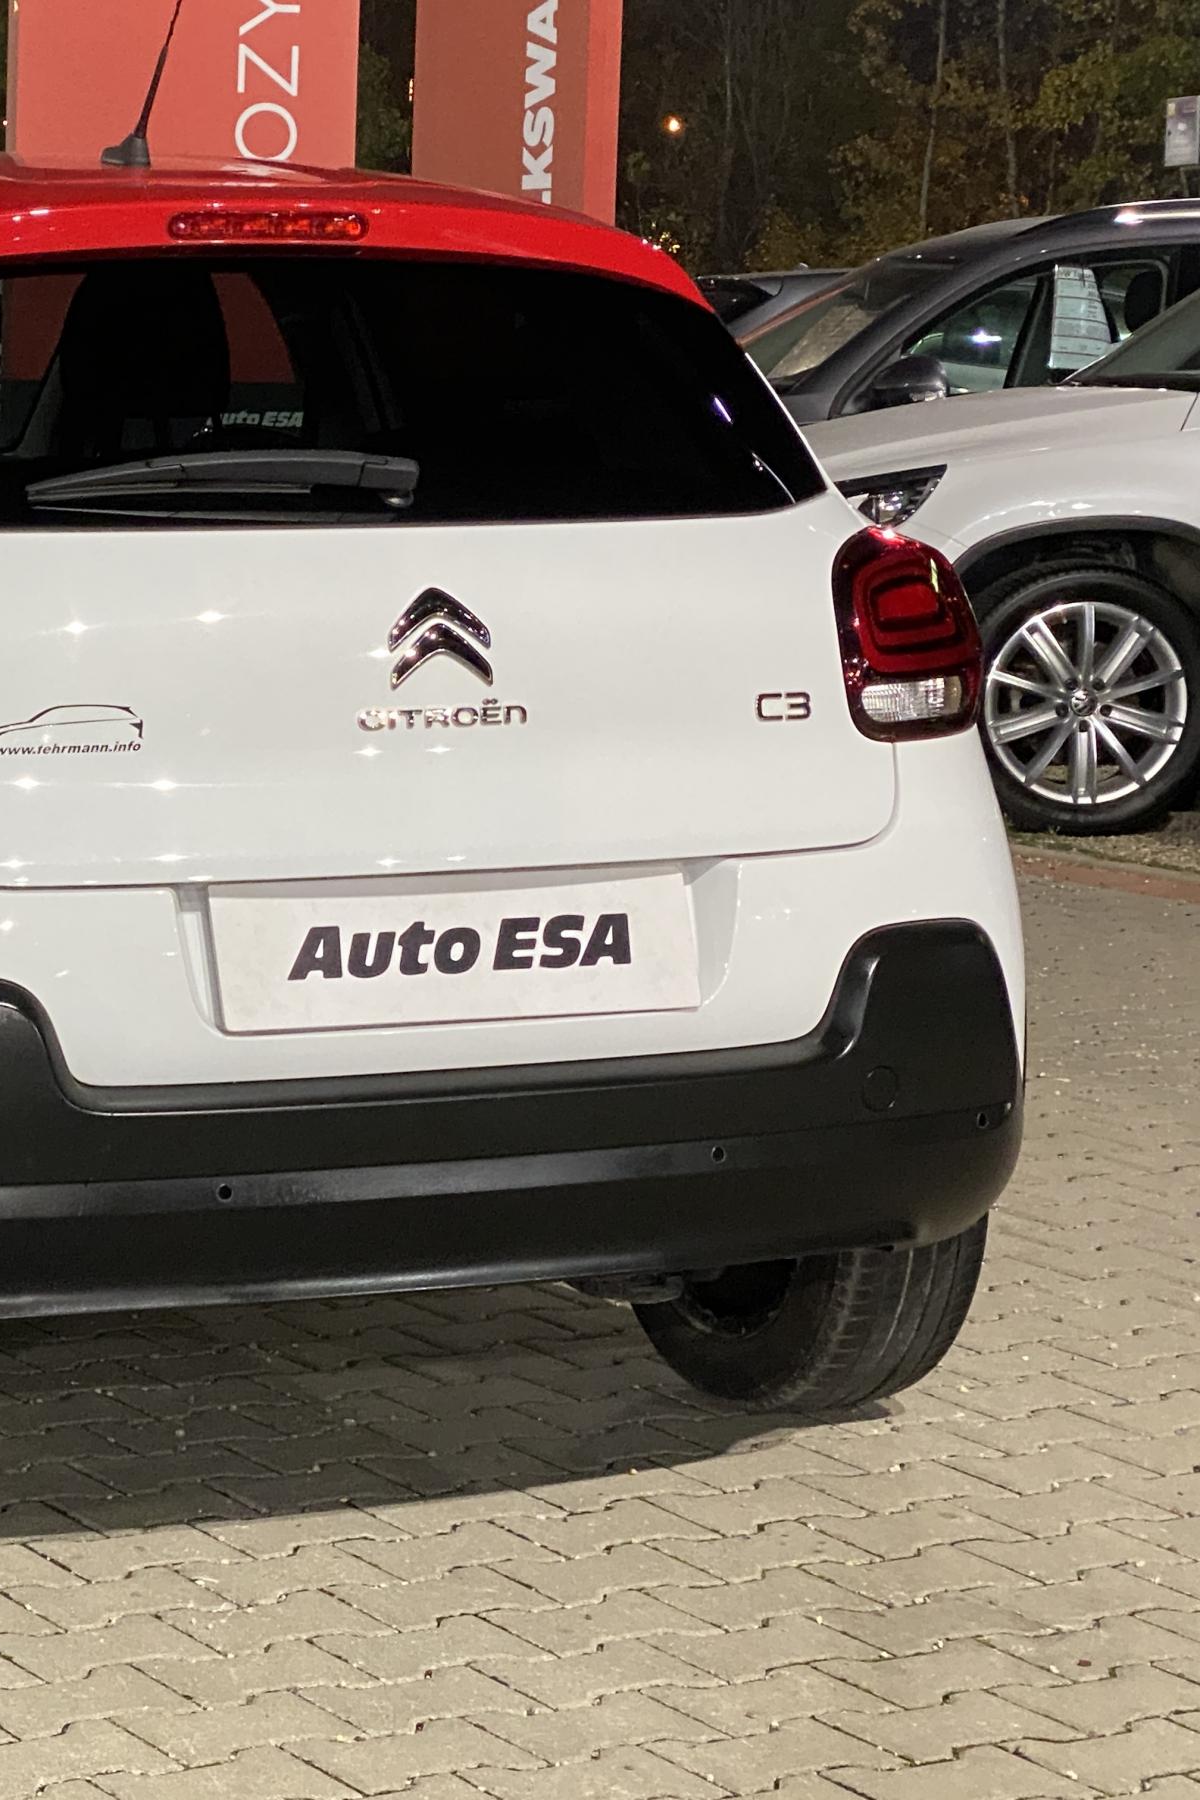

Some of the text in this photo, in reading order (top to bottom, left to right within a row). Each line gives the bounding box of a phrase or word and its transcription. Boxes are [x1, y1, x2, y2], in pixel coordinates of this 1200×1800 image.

[261, 411, 304, 428] ESA
[756, 692, 811, 721] C3
[287, 913, 632, 981] Auto ESA
